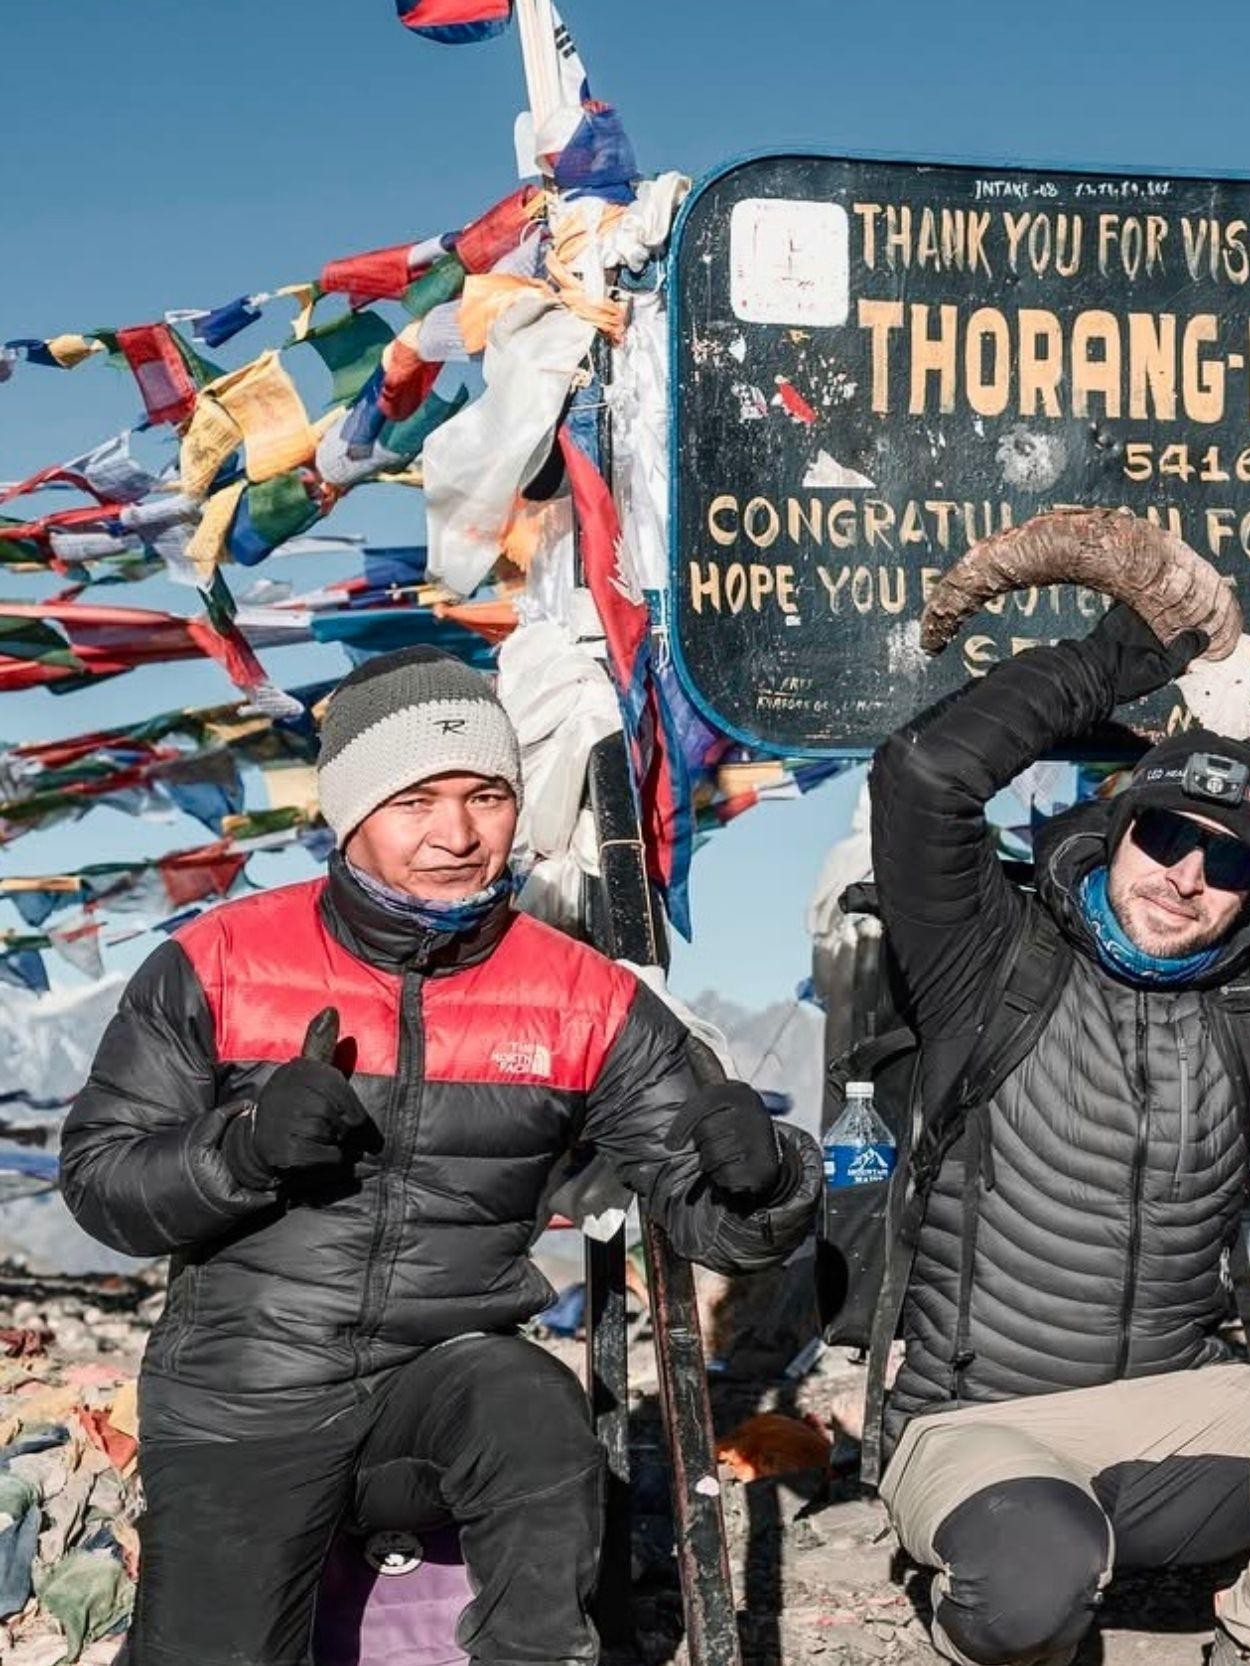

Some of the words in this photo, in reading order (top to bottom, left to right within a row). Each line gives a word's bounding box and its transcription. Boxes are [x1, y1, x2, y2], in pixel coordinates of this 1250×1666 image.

[853, 203, 992, 277] THANK
[1003, 212, 1083, 277] YOU
[1099, 214, 1169, 281] FOR
[689, 560, 797, 615] HOPE
[817, 566, 906, 614] YOU
